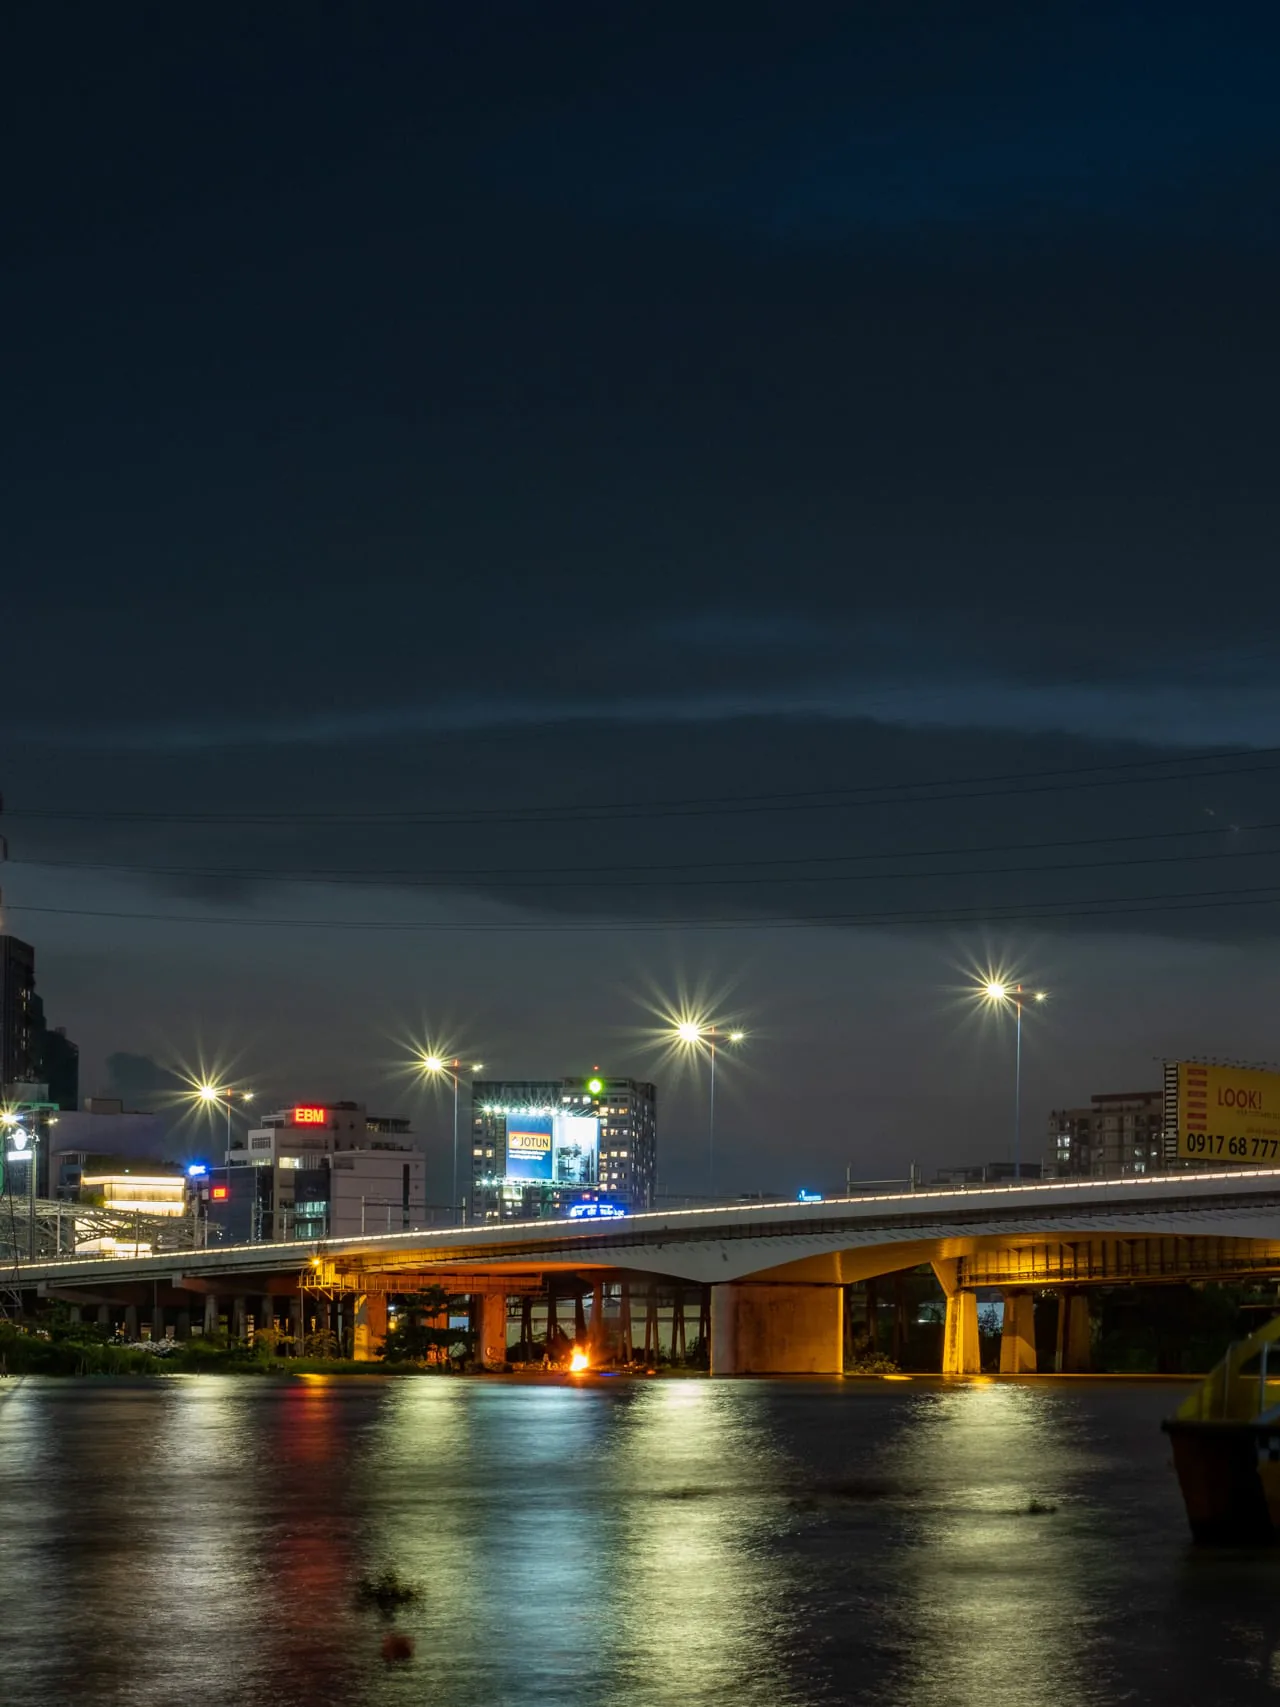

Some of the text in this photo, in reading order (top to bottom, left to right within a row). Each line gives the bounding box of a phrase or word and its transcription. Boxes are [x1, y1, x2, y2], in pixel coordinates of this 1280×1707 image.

[1217, 1086, 1262, 1110] LOOK!
[295, 1108, 324, 1123] EBM
[519, 1136, 549, 1148] JOTUN
[1187, 1133, 1225, 1154] 0917
[1228, 1136, 1247, 1156] 68
